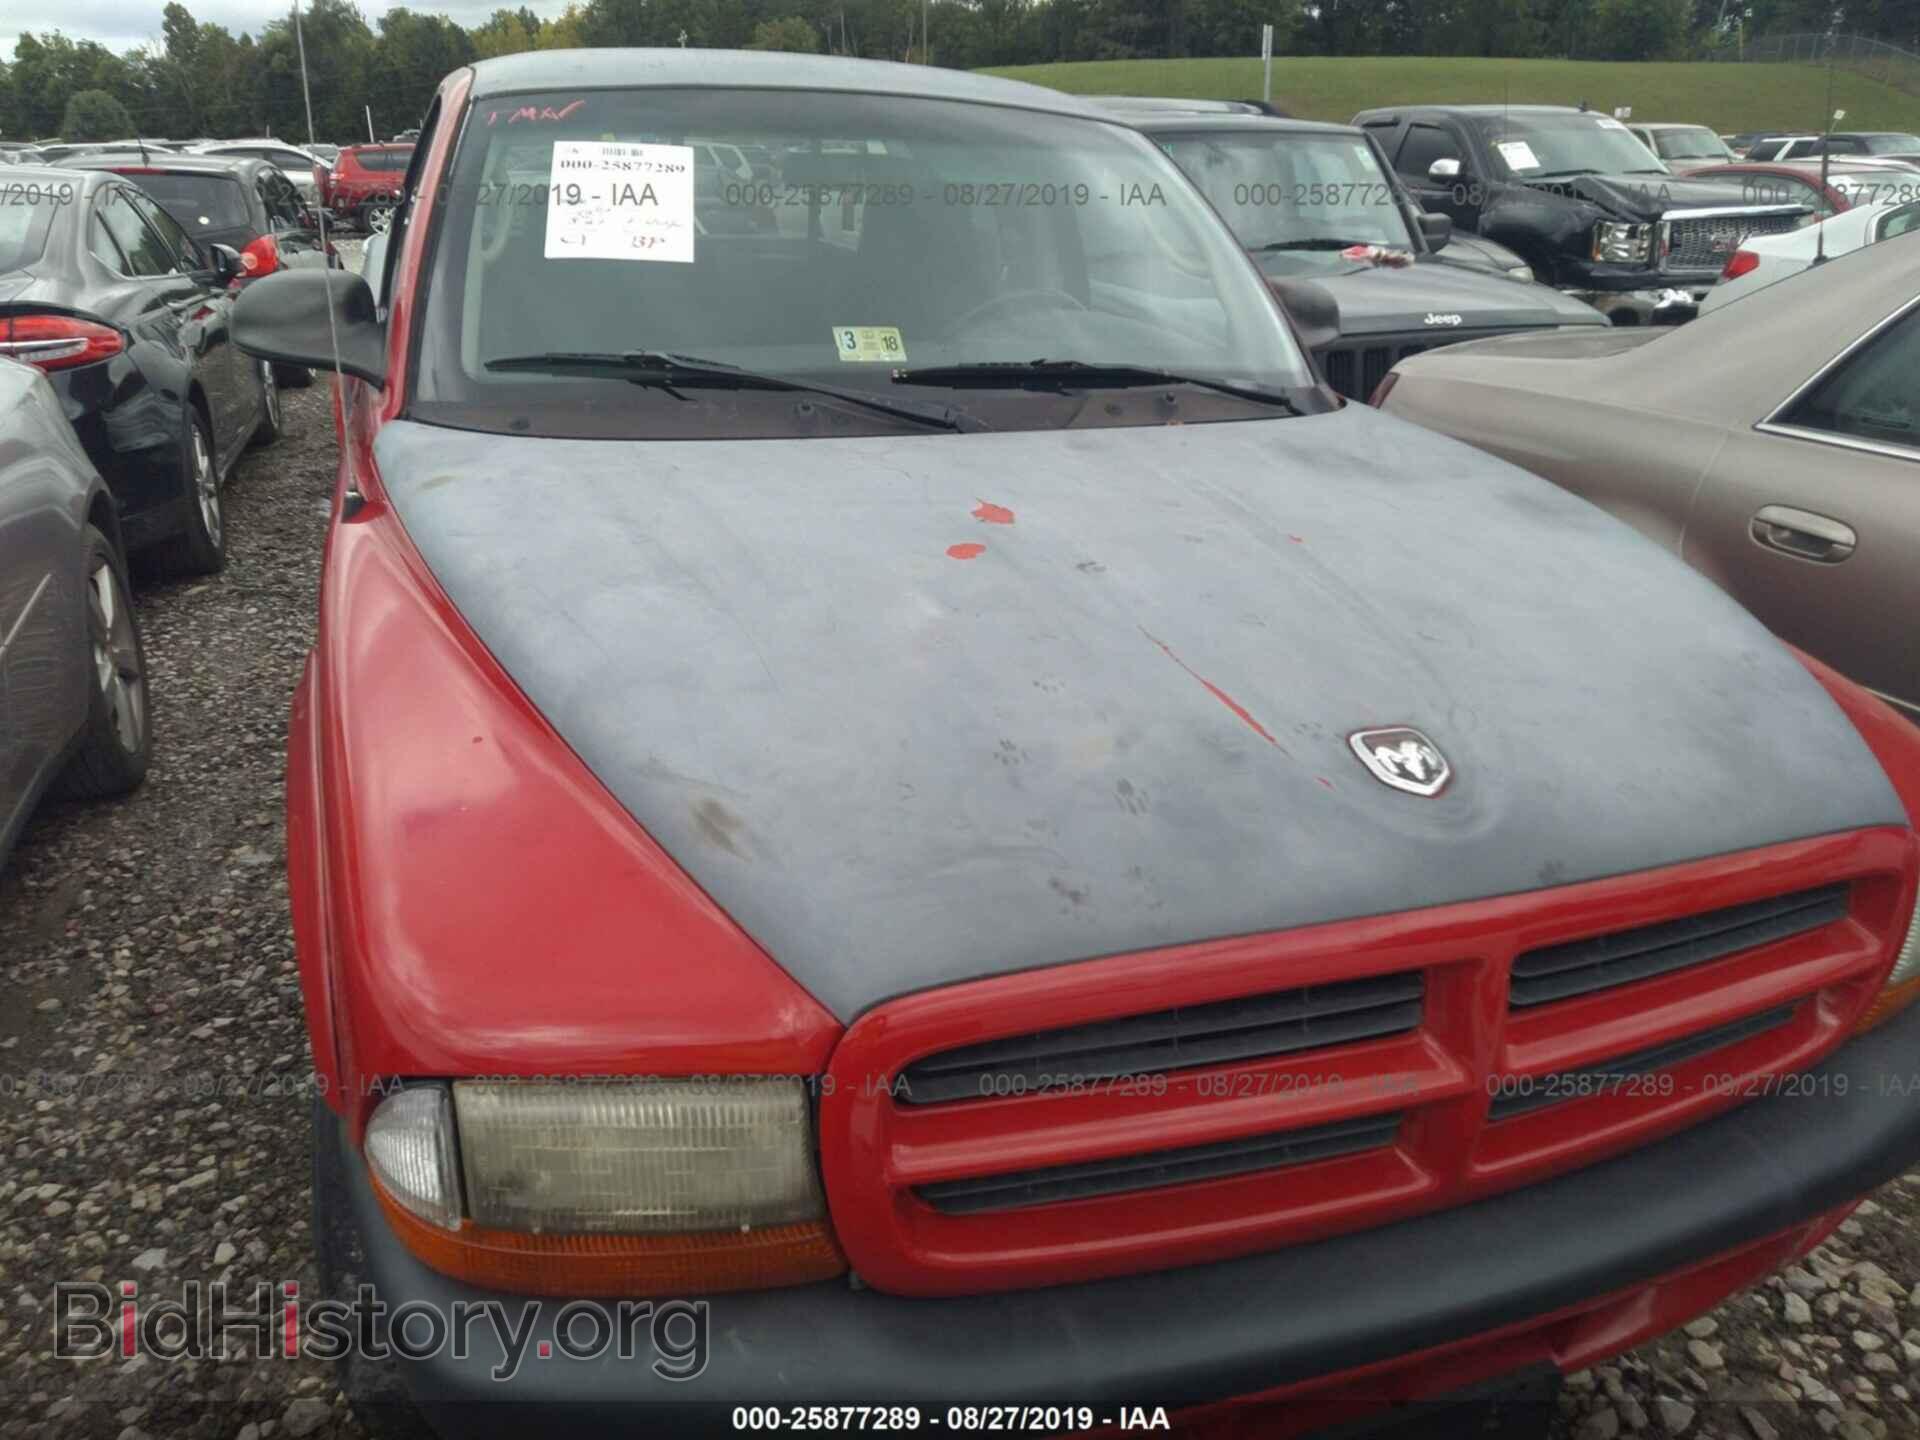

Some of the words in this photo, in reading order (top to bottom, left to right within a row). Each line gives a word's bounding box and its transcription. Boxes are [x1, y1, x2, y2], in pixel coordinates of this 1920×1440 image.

[560, 158, 686, 174] 000-25877289
[1423, 312, 1462, 326] Jeep
[844, 330, 857, 350] 3
[881, 335, 899, 352] 18
